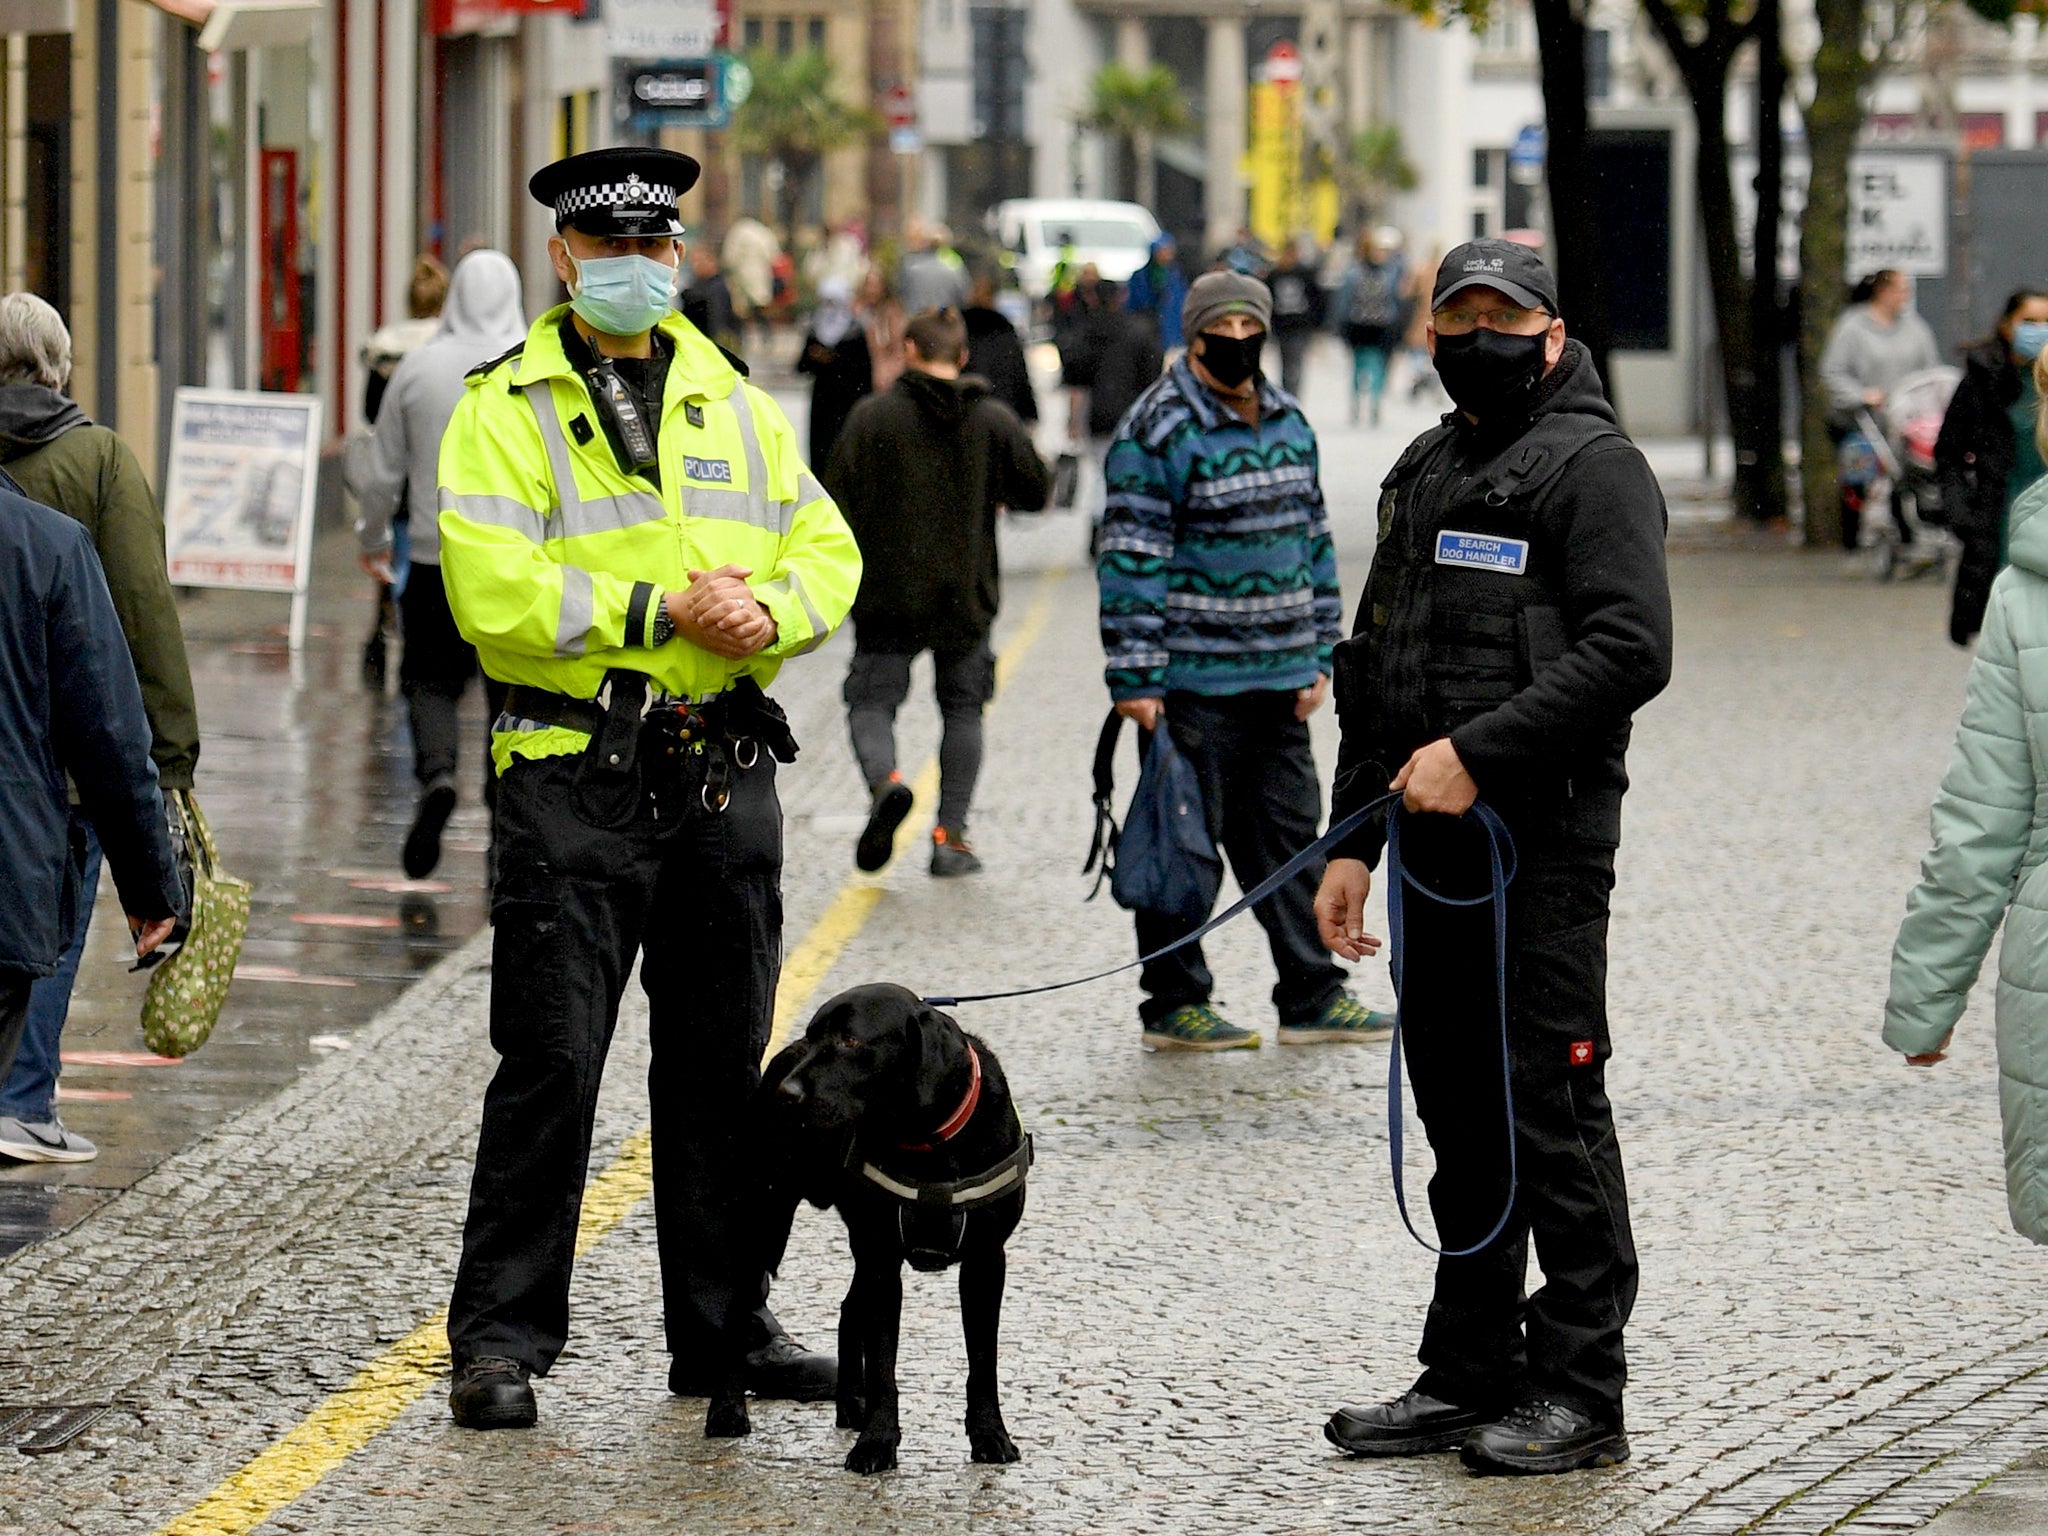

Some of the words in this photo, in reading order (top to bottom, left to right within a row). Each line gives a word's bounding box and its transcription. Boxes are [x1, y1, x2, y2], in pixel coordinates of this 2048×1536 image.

[684, 458, 731, 480] POLICE
[1458, 538, 1501, 553] SEARCH
[1442, 548, 1463, 559] DOG
[1465, 551, 1516, 566] HANDLER
